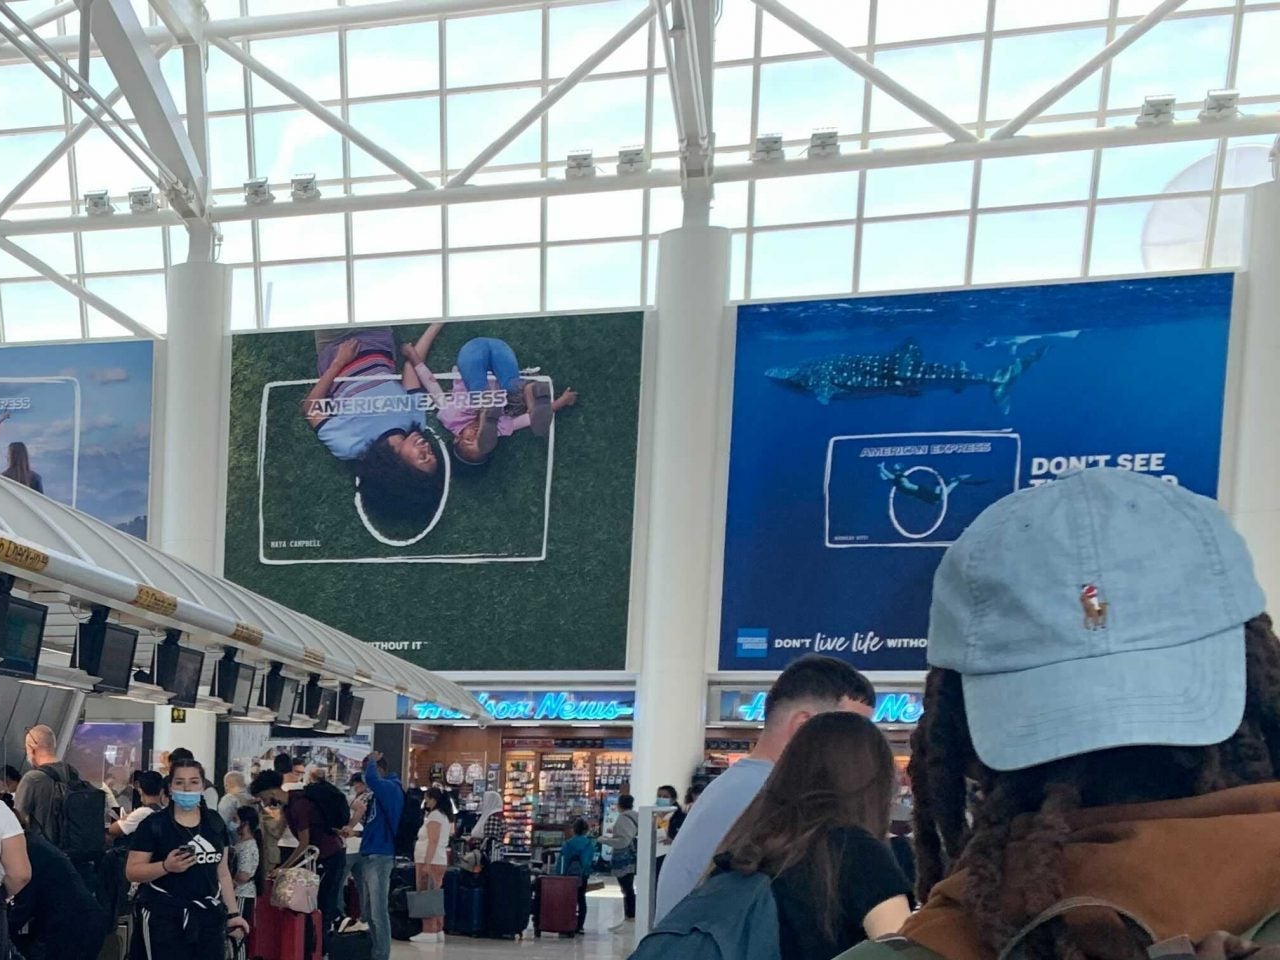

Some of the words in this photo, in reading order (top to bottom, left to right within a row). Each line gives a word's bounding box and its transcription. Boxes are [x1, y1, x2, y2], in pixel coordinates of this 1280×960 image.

[307, 395, 411, 416] AMERICAN
[416, 390, 508, 410] EXPRESS
[859, 445, 929, 457] AMERICAN
[930, 442, 991, 455] EXPRESS
[1031, 454, 1111, 476] DON'T
[1116, 452, 1166, 471] SEE
[289, 539, 321, 548] CAMPBELL
[774, 638, 812, 649] DON'T
[814, 632, 850, 652] live
[852, 631, 884, 654] life
[886, 638, 928, 649] WITHO
[534, 691, 632, 721] News
